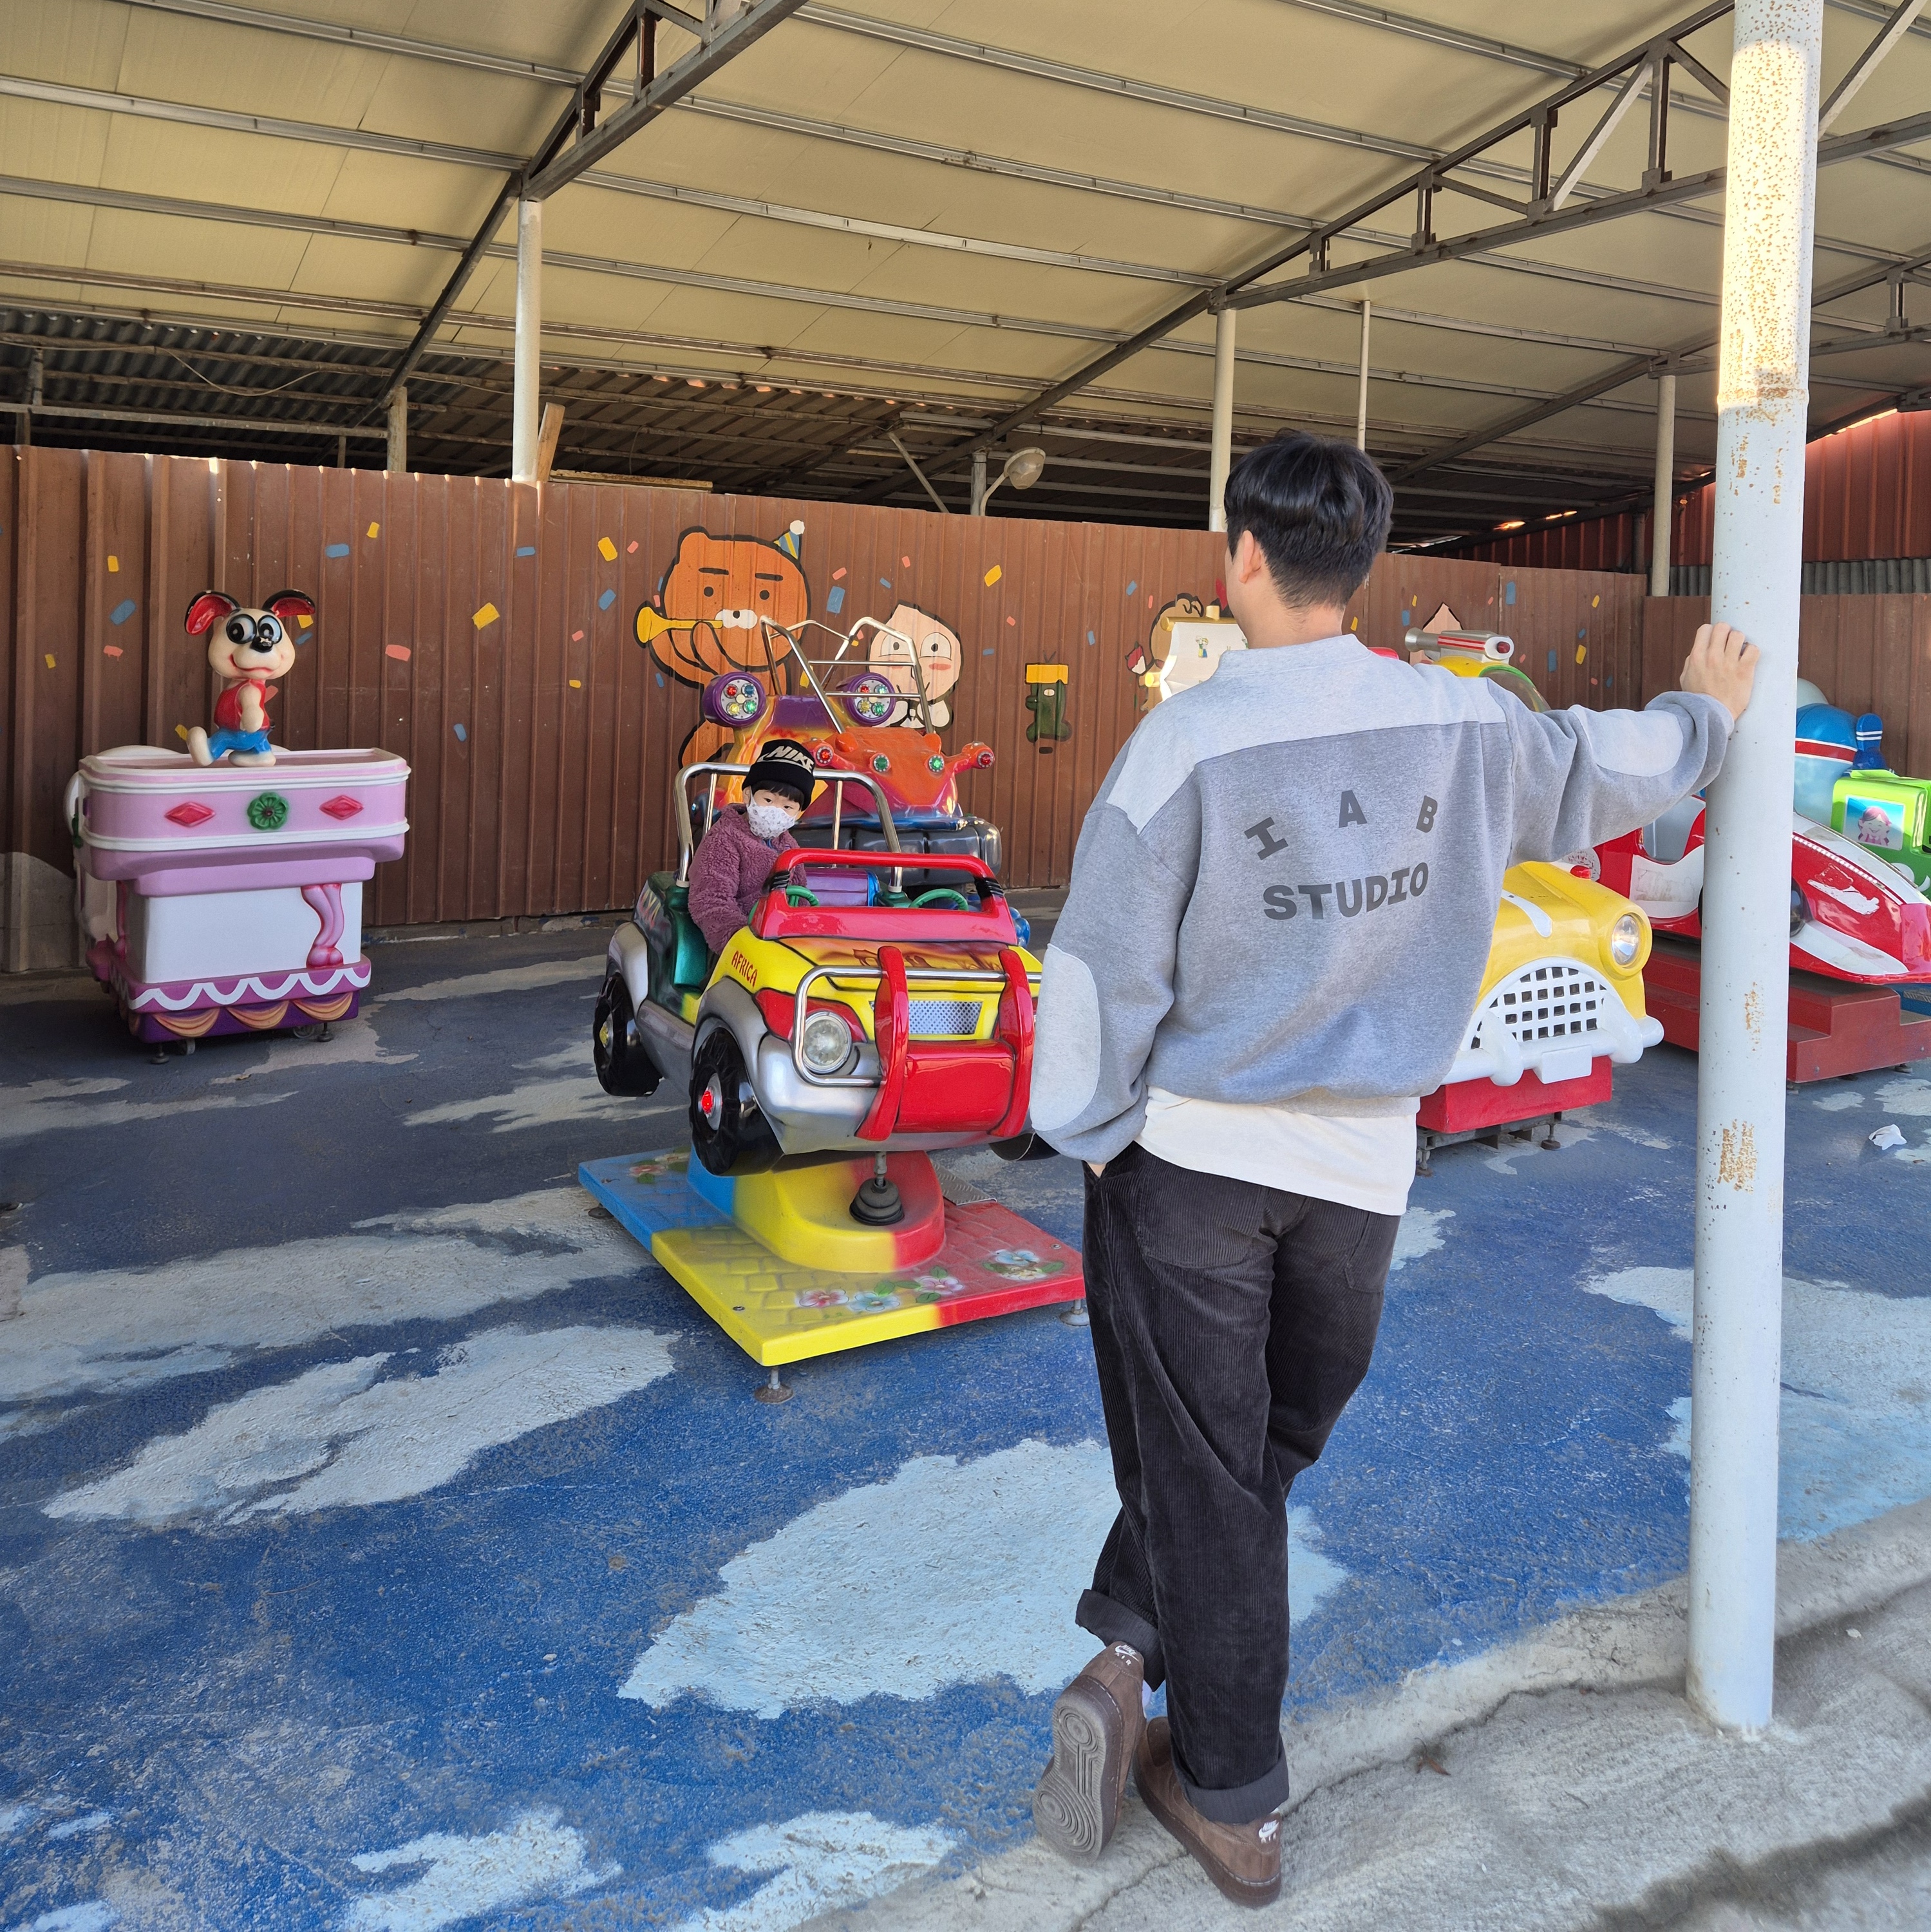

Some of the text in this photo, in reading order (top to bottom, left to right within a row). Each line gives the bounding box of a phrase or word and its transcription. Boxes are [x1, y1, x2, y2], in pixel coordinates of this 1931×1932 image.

[765, 746, 814, 774] NIKE
[1263, 862, 1429, 920] STUDIO
[731, 951, 758, 987] AFRICA
